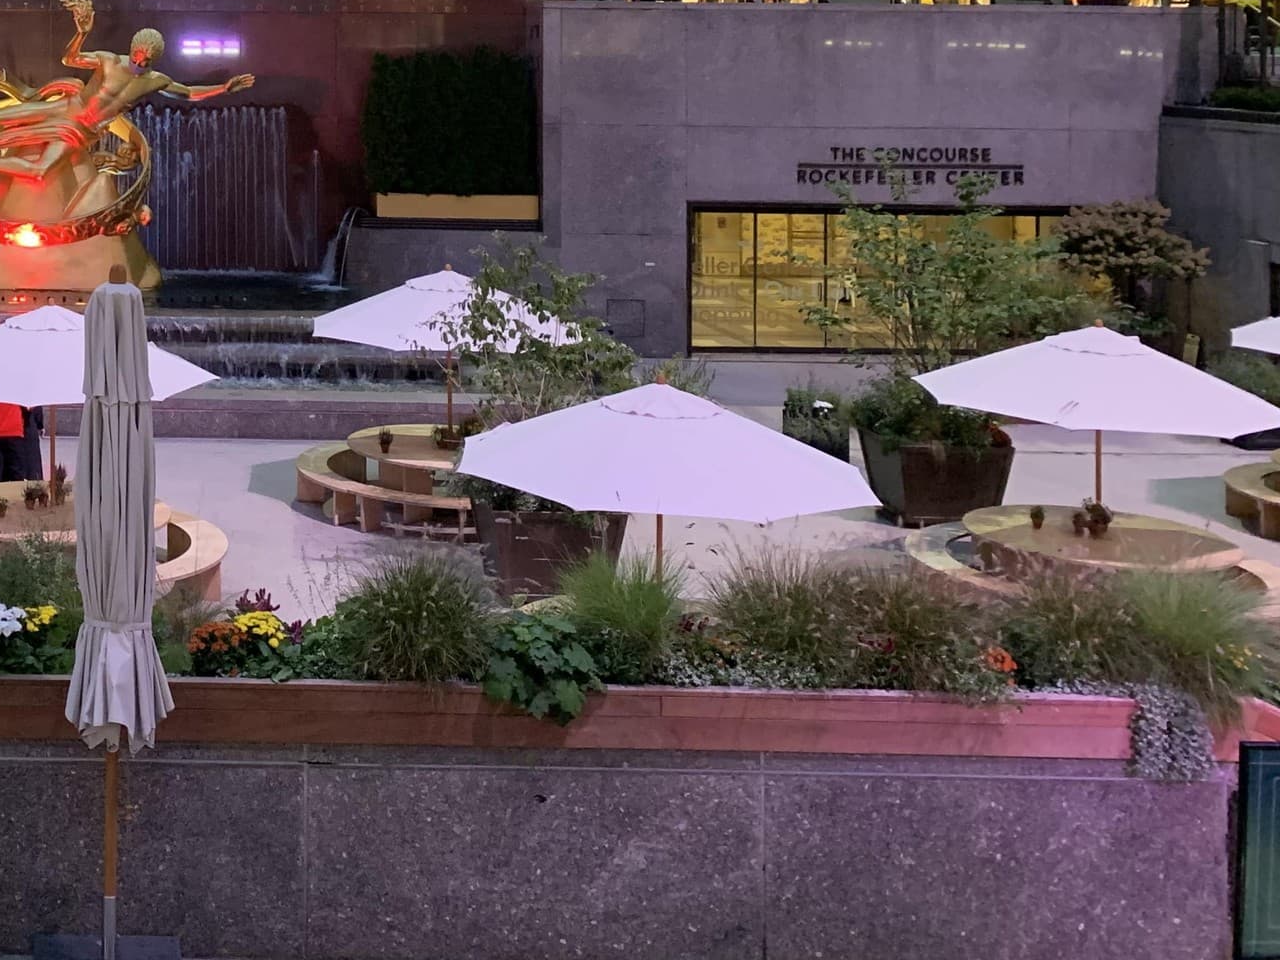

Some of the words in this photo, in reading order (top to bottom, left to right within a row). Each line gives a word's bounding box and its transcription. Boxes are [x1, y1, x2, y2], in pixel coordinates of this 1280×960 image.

[830, 147, 866, 162] THE
[873, 147, 992, 163] CONCOURSE
[797, 169, 936, 186] ROCKEFELER
